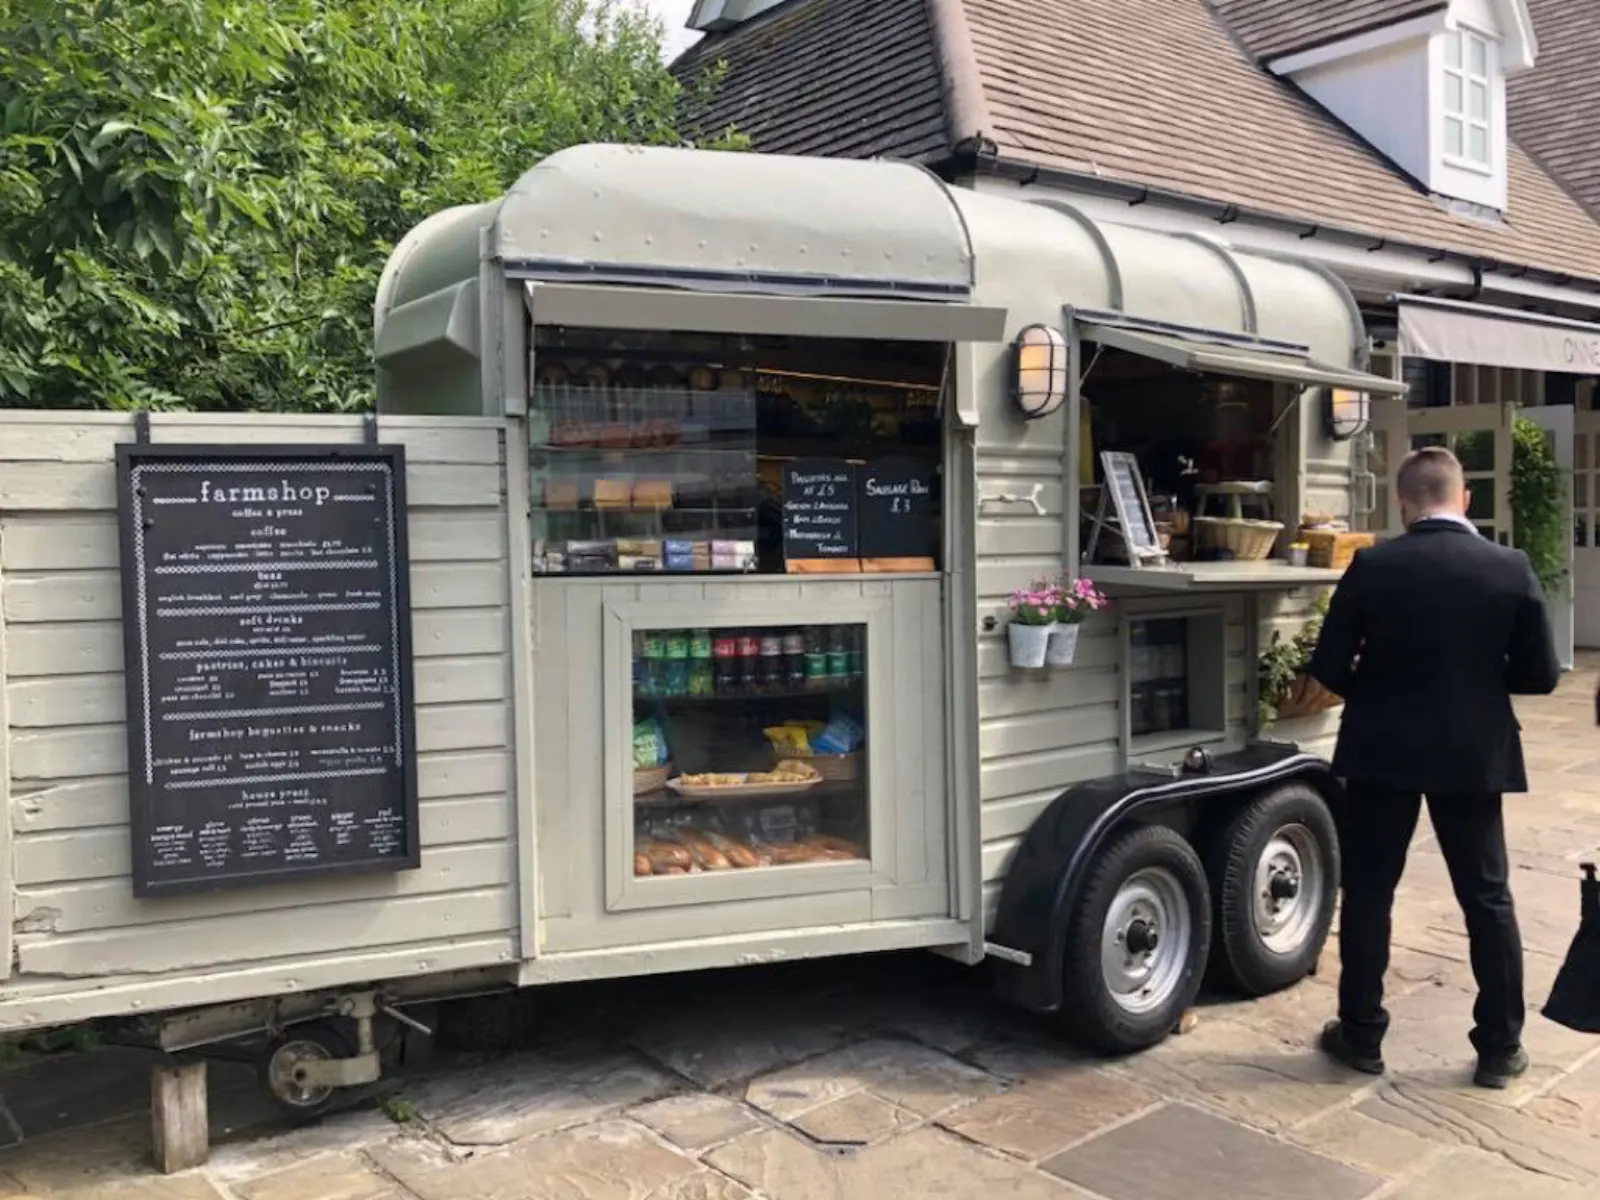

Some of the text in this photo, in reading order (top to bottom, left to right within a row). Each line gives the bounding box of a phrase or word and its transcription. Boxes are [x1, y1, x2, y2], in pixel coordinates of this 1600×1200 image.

[201, 480, 330, 505] farmshop
[250, 525, 287, 537] coffee
[240, 614, 303, 626] soft drinks
[196, 661, 249, 673] pastries,
[252, 658, 285, 669] cakes
[189, 729, 244, 741] farmshop
[248, 725, 304, 738] baguettes
[321, 722, 361, 733] snacks
